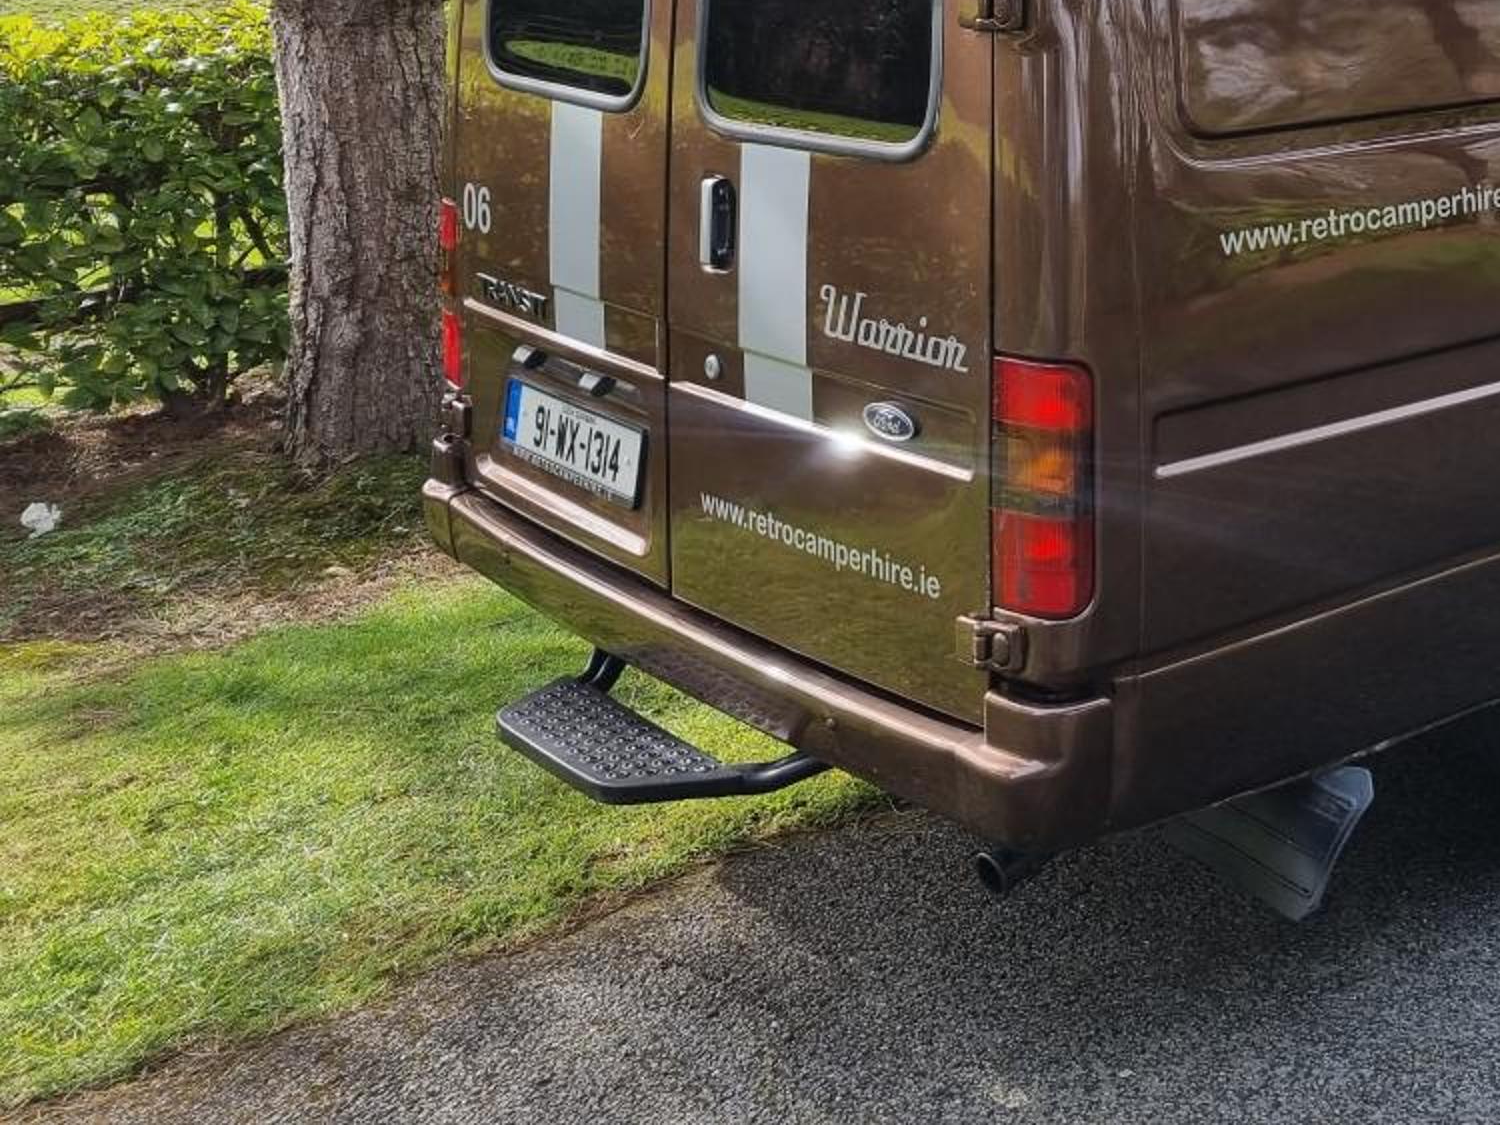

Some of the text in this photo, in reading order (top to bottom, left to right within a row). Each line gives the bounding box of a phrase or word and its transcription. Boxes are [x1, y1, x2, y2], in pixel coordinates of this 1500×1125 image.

[463, 183, 491, 233] 06
[534, 406, 621, 481] 91-WX-1314
[701, 492, 941, 599] www.retrocamperhire.ie
